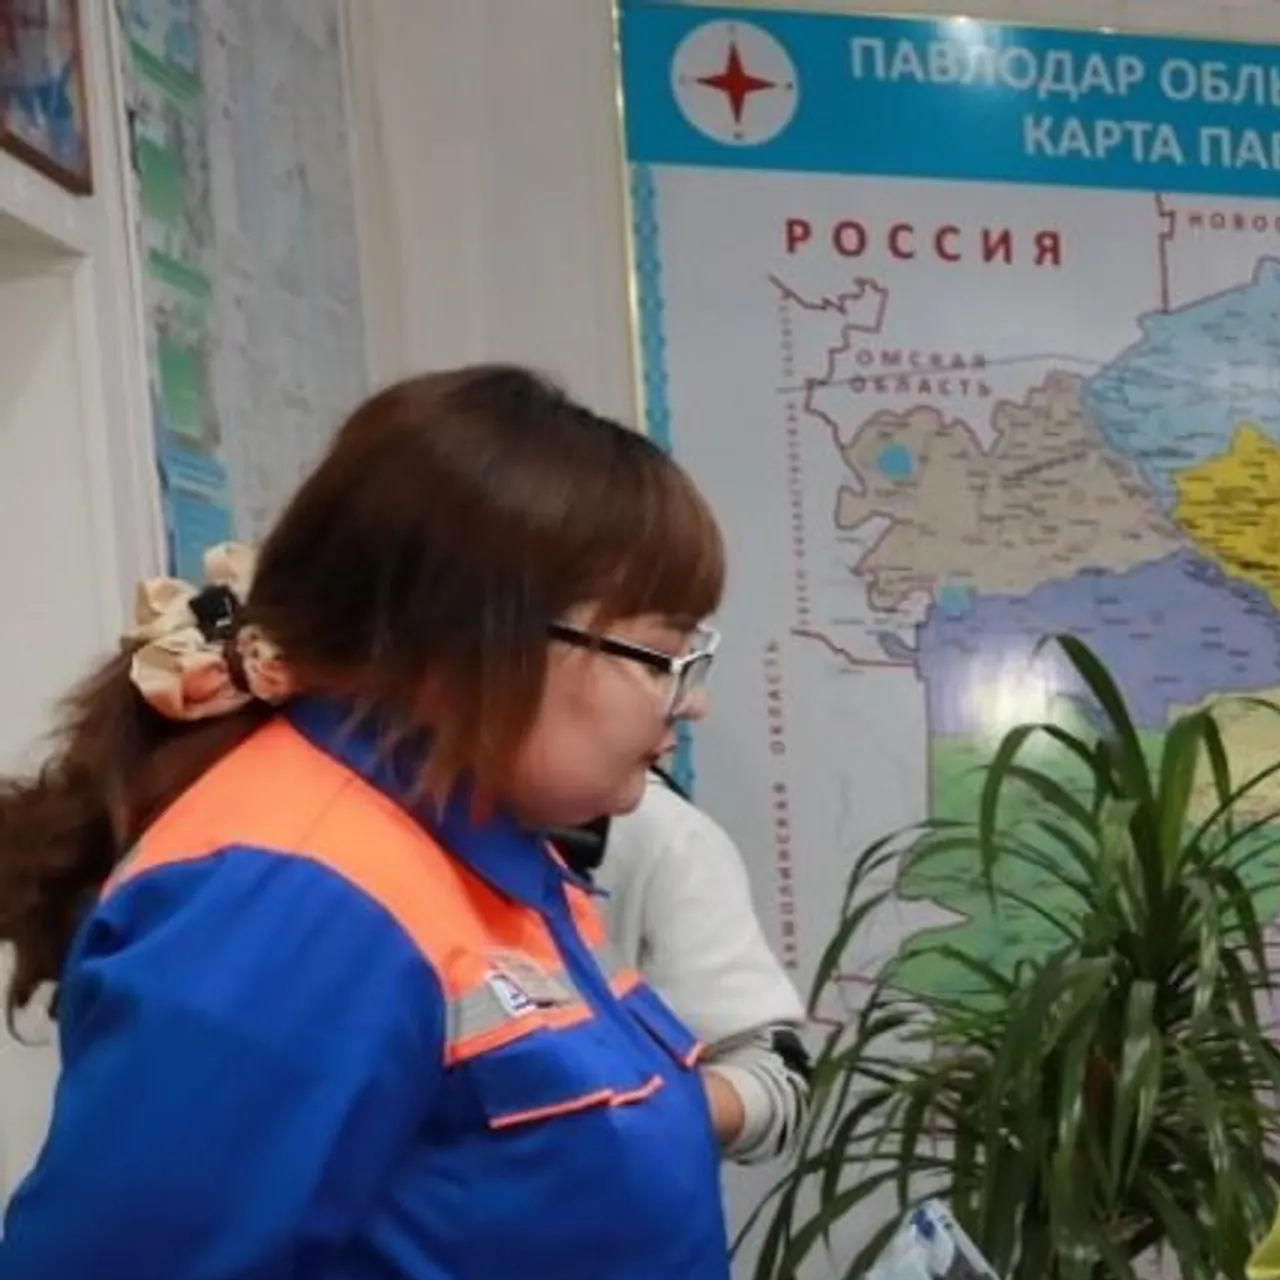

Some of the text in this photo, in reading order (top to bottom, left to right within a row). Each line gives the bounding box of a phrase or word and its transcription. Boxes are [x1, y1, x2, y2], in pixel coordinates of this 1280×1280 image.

[850, 36, 1145, 102] ПАВЛОДАР
[1022, 112, 1185, 166] КАРТА
[785, 217, 1062, 267] РОССИЯ
[855, 349, 987, 371] ОМСКАЯ
[848, 374, 992, 398] ОБЛАСТЬ
